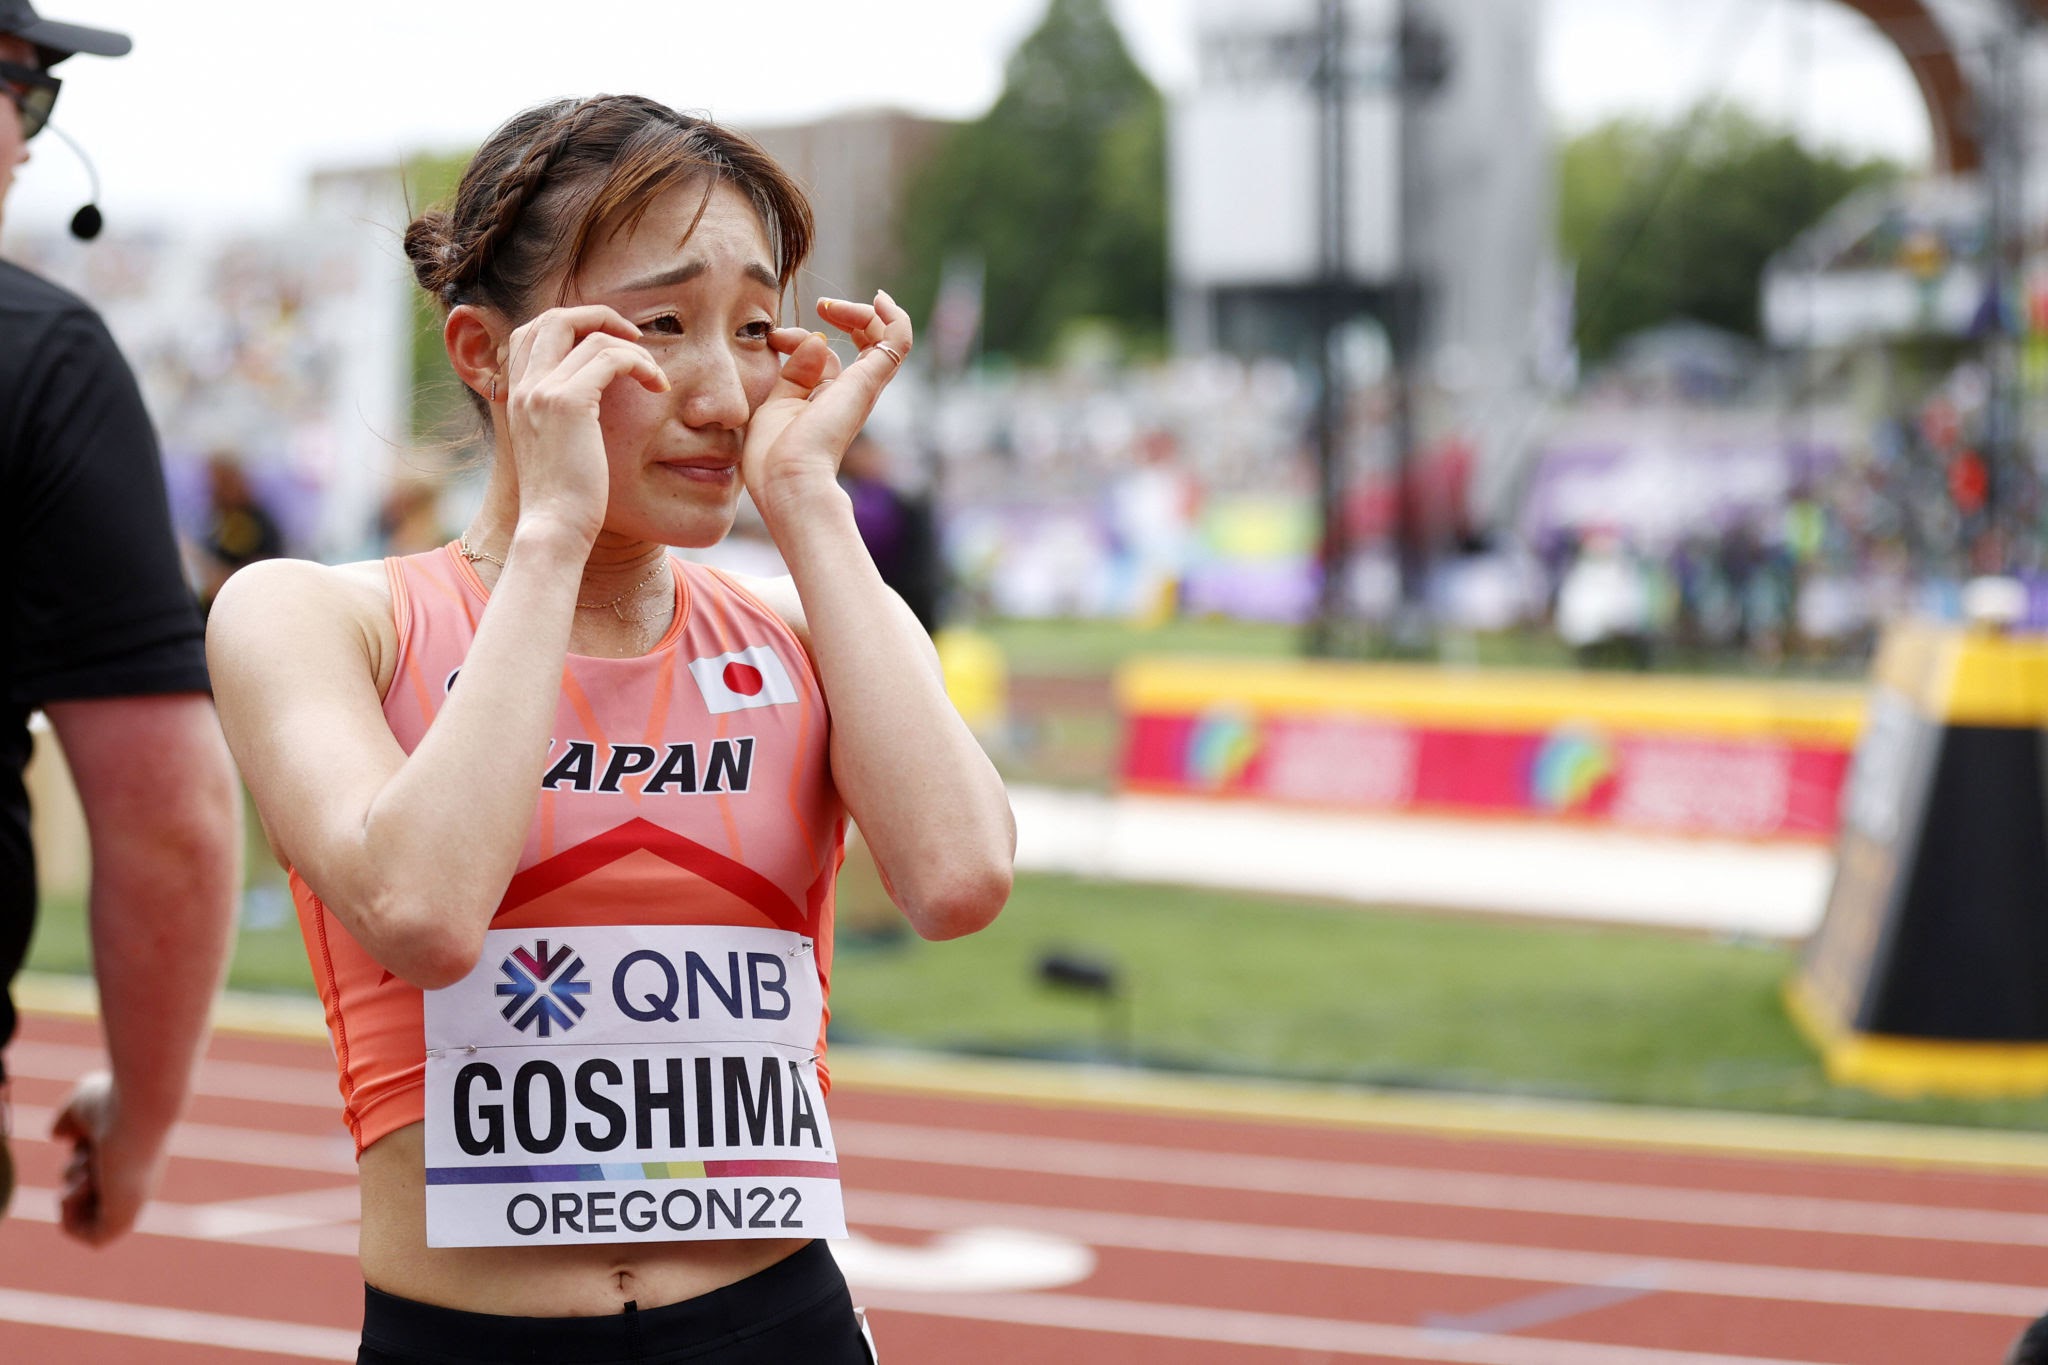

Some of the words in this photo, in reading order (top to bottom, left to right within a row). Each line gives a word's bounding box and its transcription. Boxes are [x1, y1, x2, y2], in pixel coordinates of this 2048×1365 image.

[541, 737, 755, 794] APAN
[612, 949, 791, 1023] QNB
[453, 1056, 823, 1156] GOSHIMA
[506, 1186, 803, 1234] OREGON22
